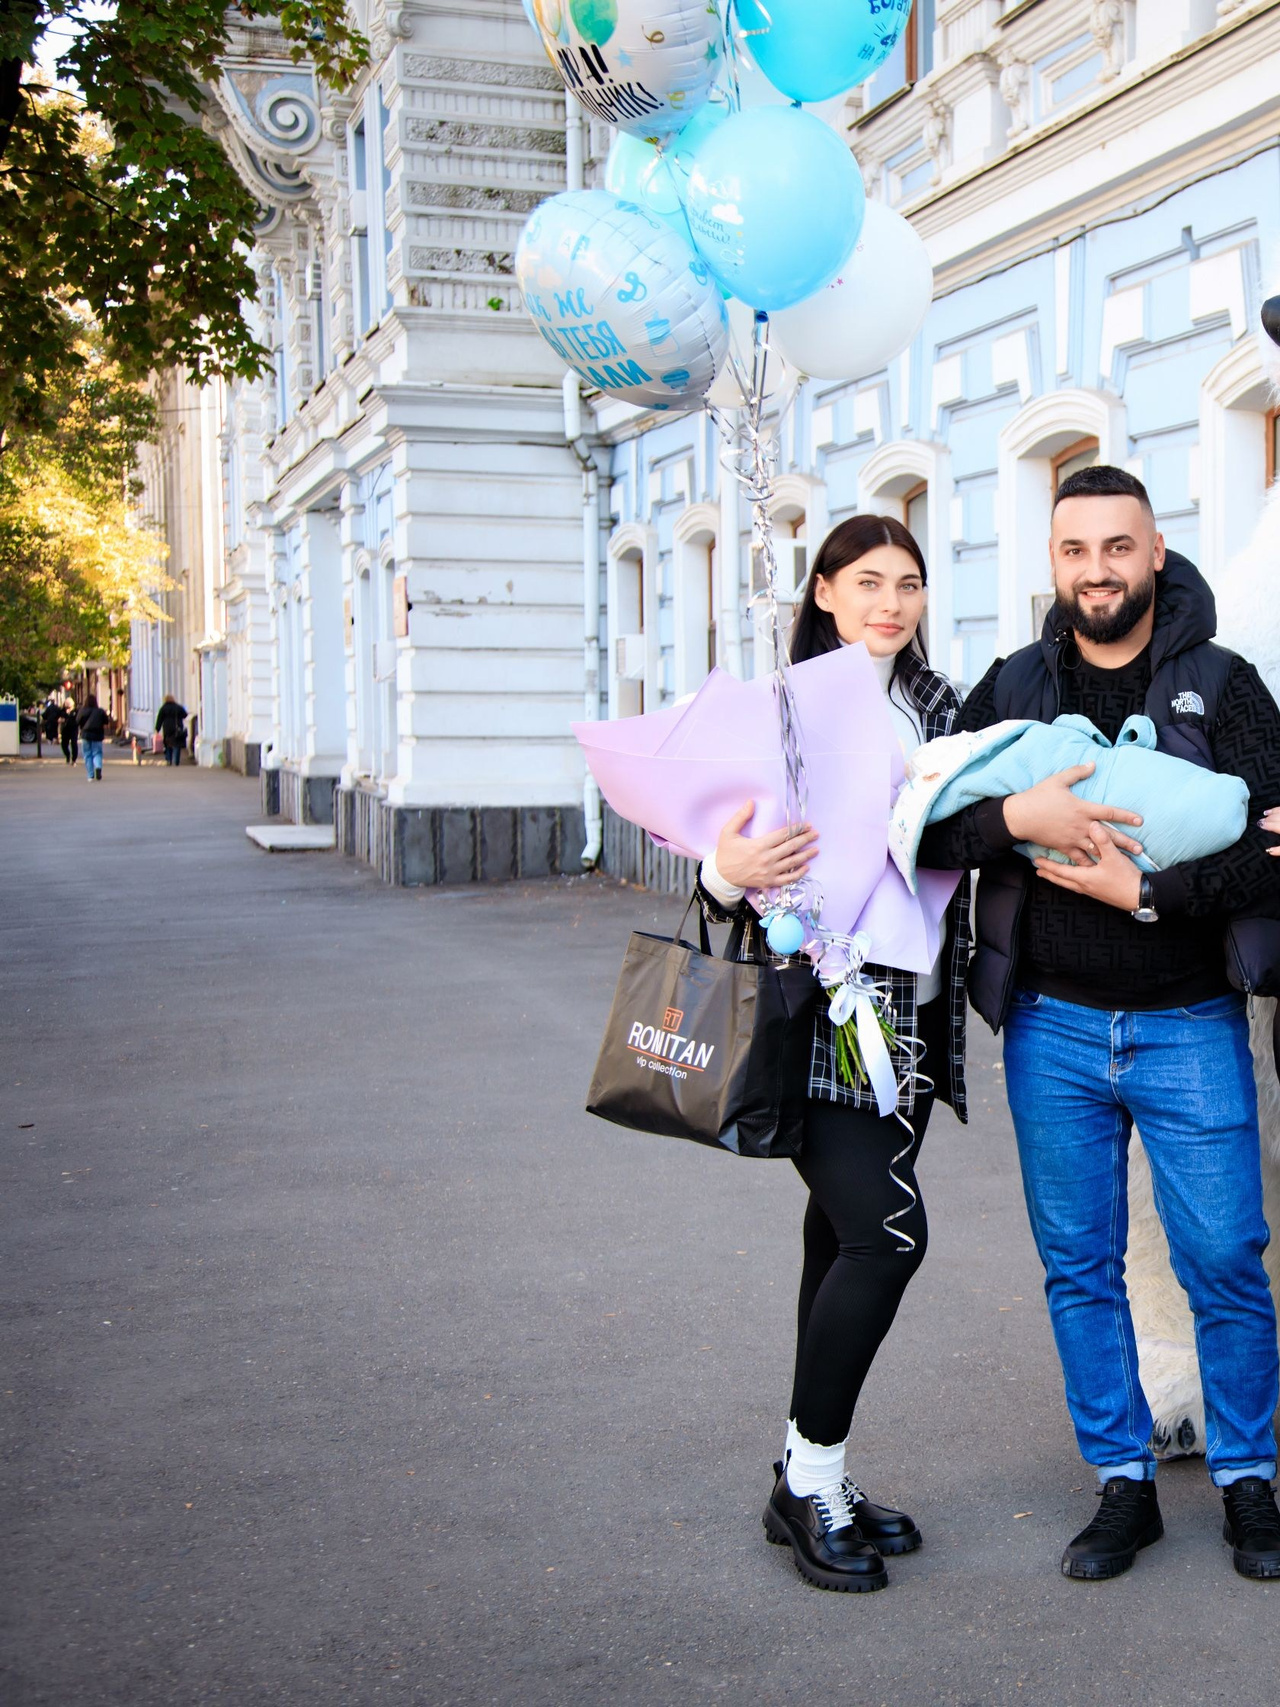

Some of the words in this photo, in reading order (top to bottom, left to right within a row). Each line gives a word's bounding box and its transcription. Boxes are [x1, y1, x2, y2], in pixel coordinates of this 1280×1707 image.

[556, 320, 628, 361] ТЕБЯ
[1178, 691, 1192, 699] THE
[648, 1060, 688, 1080] collection
